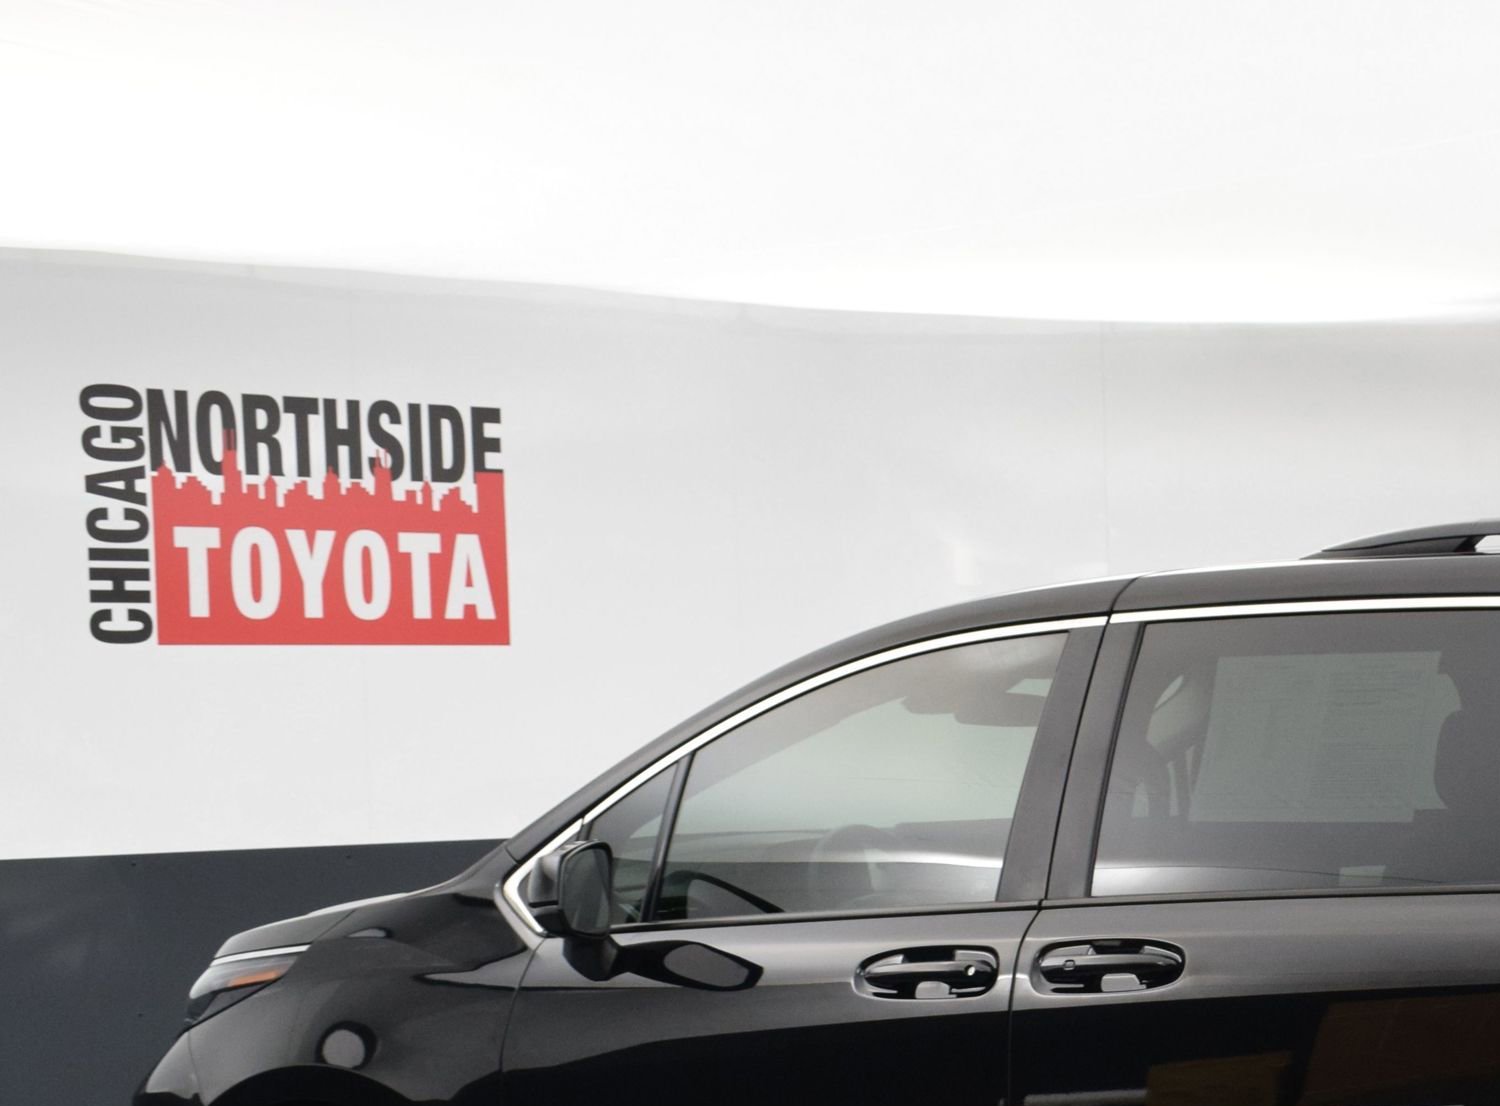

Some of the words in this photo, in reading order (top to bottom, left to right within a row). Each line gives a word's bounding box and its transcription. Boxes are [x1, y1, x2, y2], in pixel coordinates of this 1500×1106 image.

[146, 388, 502, 484] NORTHSIDE
[79, 383, 153, 644] CHICAGO
[172, 526, 497, 620] TOYOTA
